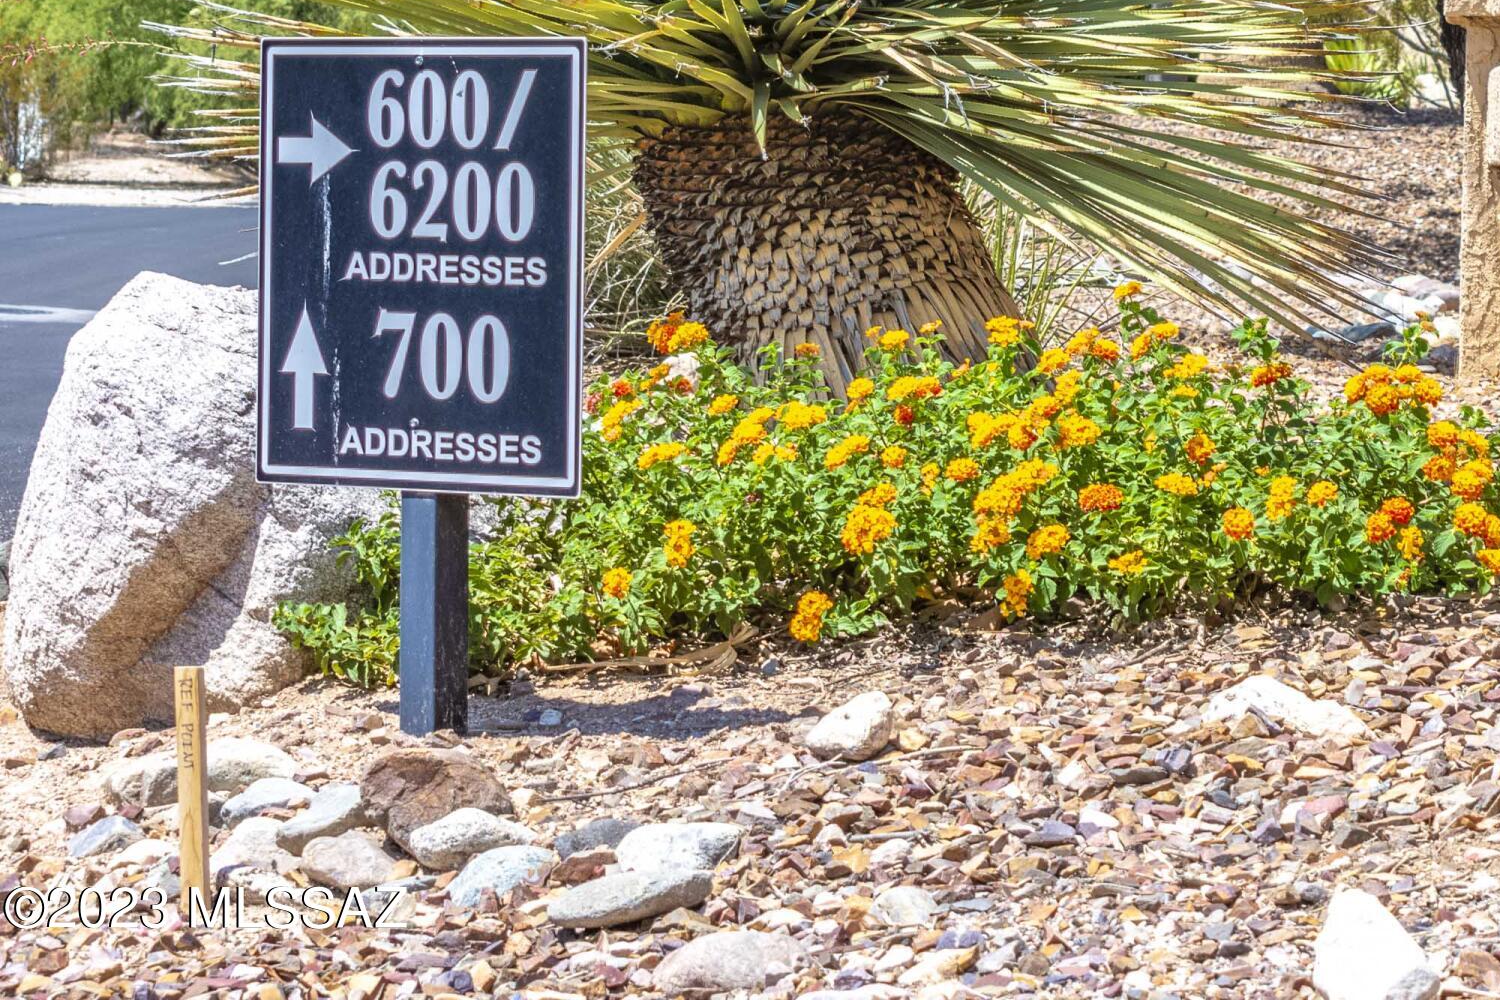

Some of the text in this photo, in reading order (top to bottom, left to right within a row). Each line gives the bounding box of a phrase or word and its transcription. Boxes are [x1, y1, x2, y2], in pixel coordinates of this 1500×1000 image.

[367, 68, 539, 151] 600/
[369, 160, 536, 243] 6200
[341, 252, 548, 287] ADDRESSES
[371, 307, 511, 403] 700
[340, 425, 543, 465] ADDRESSES
[178, 677, 193, 712] REF
